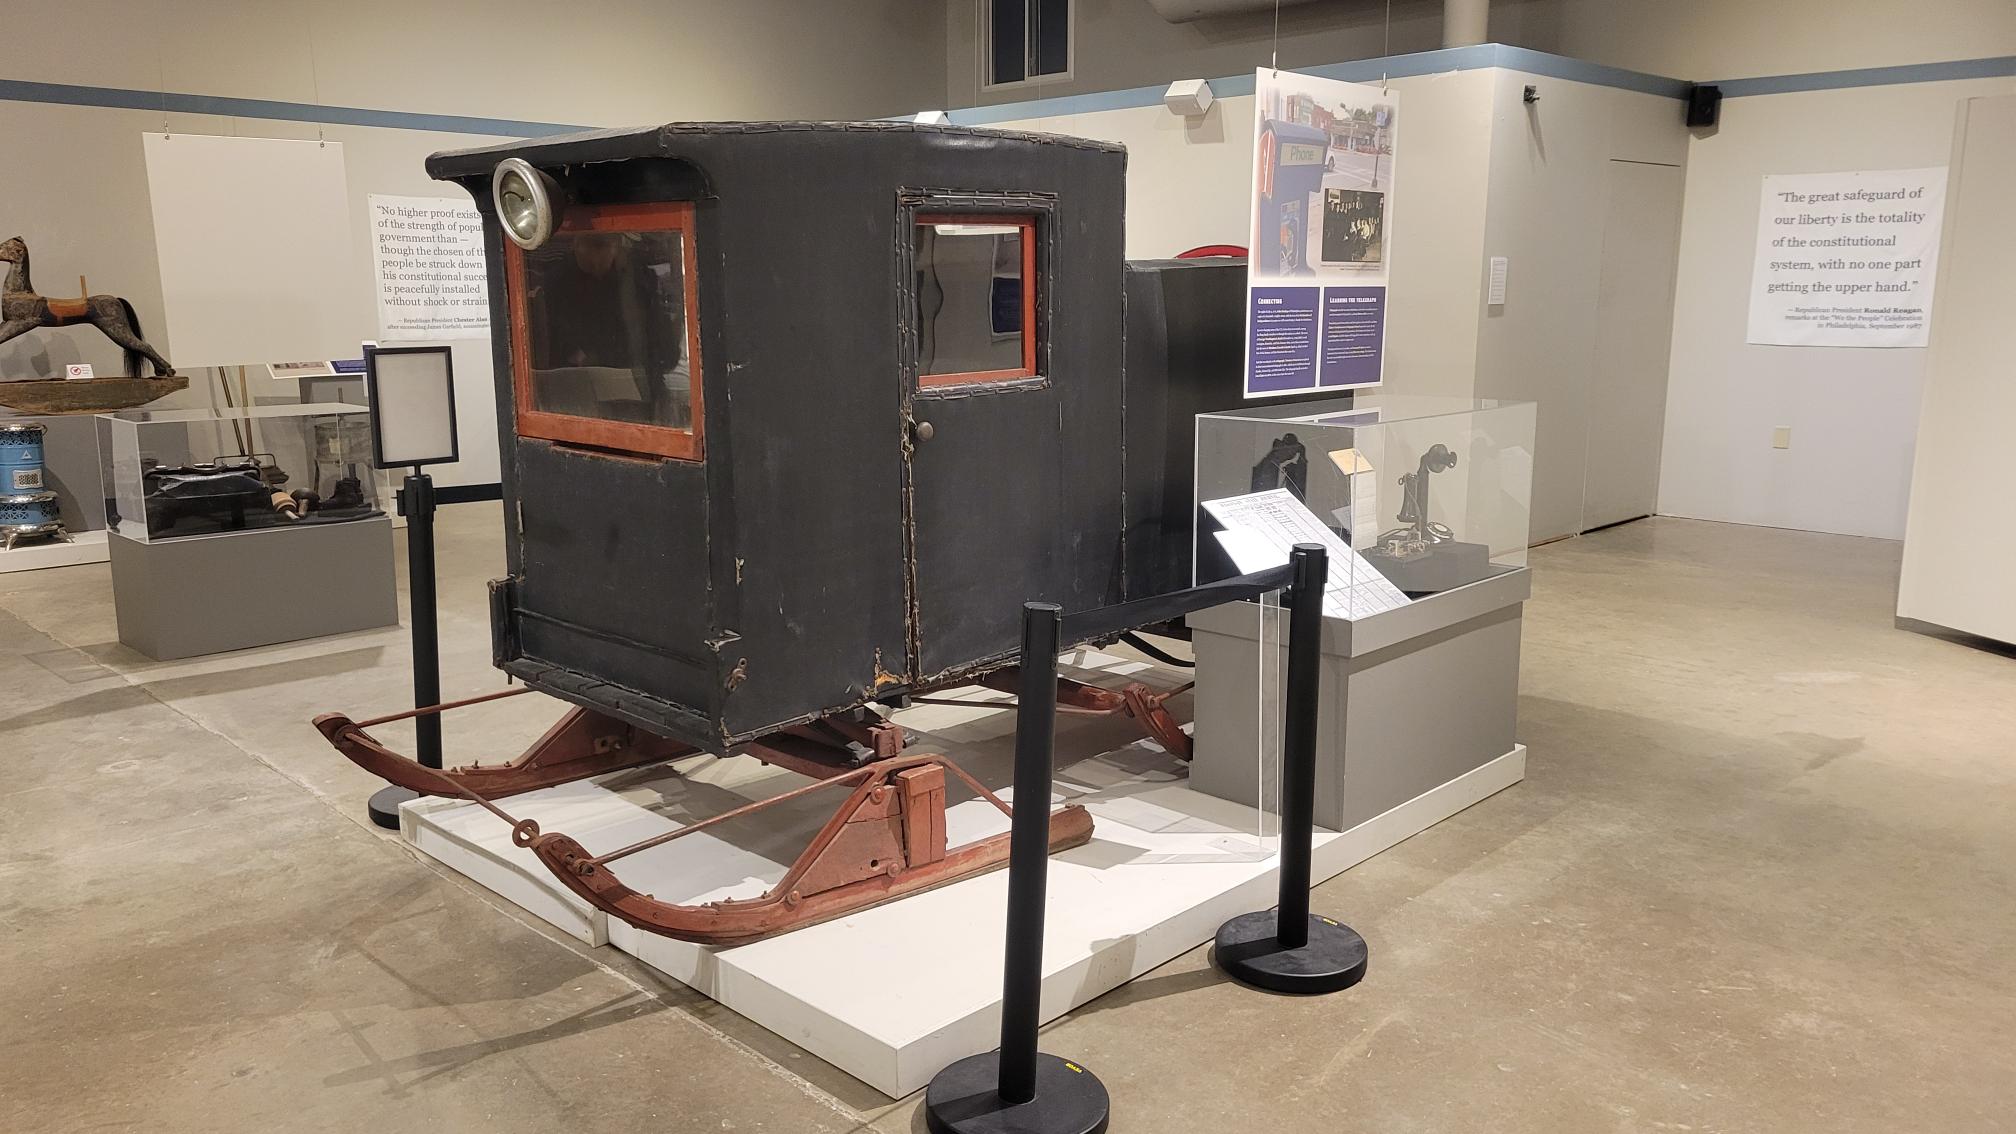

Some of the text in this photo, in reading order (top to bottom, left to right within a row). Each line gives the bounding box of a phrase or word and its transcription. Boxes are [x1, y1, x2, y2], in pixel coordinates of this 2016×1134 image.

[1291, 145, 1314, 160] Phone
[1808, 192, 1840, 204] great
[1843, 188, 1906, 203] safeguard
[1909, 187, 1925, 199] of
[398, 207, 428, 219] higher
[430, 209, 455, 219] proof
[457, 210, 481, 219] exists
[1774, 211, 1926, 227] our liberty is the totality
[378, 219, 389, 228] of
[391, 219, 405, 229] the
[407, 221, 445, 232] strength
[447, 222, 458, 230] of
[379, 233, 436, 243] government
[437, 234, 458, 243] than
[1771, 235, 1896, 247] of the constitutional
[380, 244, 414, 257] though
[417, 245, 432, 256] the
[433, 246, 464, 256] chosen
[465, 248, 475, 256] of
[382, 259, 483, 269] people be struck down
[1769, 258, 1921, 272] system, with no one part
[383, 270, 397, 280] his
[398, 271, 462, 281] constitutional
[383, 283, 481, 295] is peacefully installed
[1767, 281, 1809, 295] getting
[1812, 281, 1832, 292] the
[1835, 284, 1873, 295] upper
[384, 296, 421, 306] without
[424, 297, 449, 306] shock
